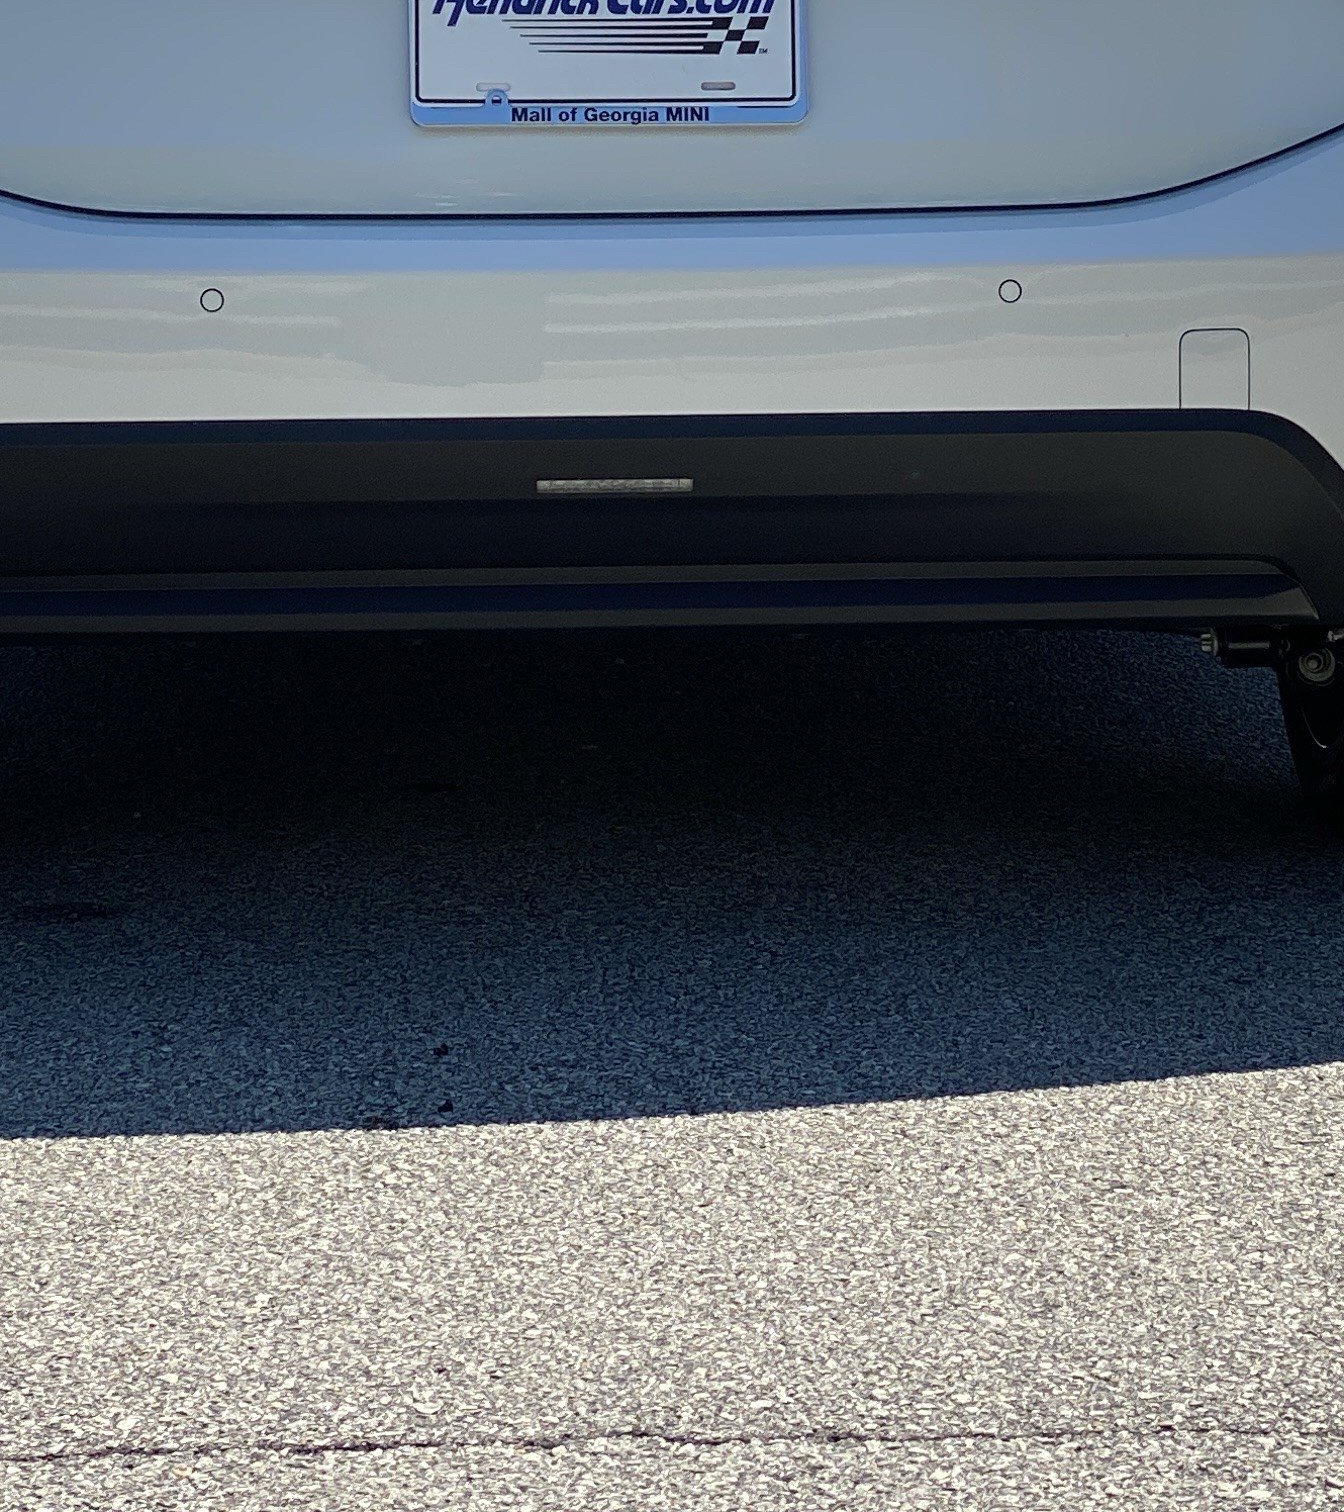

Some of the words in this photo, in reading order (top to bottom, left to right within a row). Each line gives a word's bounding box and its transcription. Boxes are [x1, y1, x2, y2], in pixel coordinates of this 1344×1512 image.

[511, 106, 552, 122] Mall
[558, 106, 578, 122] of
[583, 106, 660, 125] Georgia
[666, 106, 710, 122] MINI
